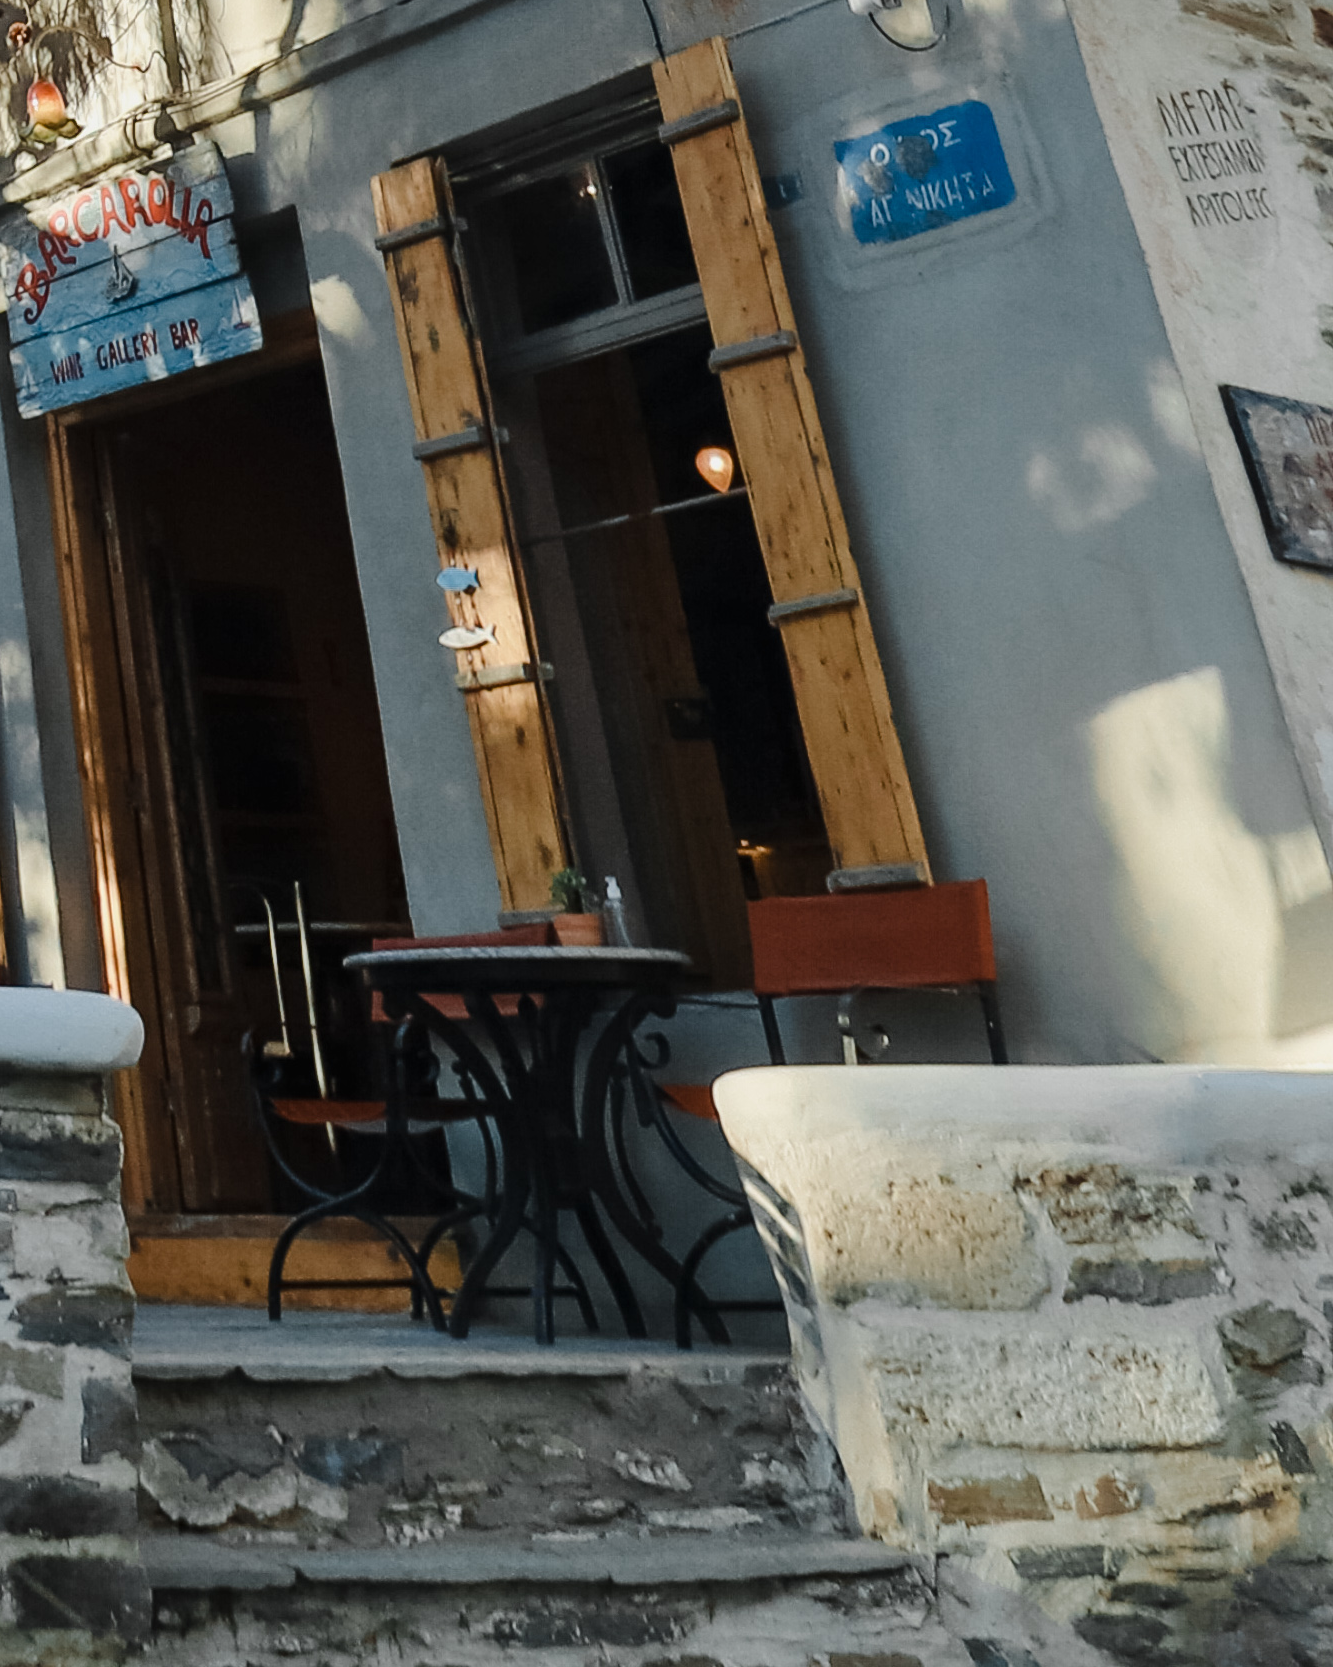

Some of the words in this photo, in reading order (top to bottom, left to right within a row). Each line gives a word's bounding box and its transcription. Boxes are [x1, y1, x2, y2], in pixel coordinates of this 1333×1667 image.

[15, 178, 213, 325] BARCAROLLA
[50, 352, 85, 385] WINE
[97, 328, 158, 370] GALLERY
[169, 317, 201, 351] BAR
